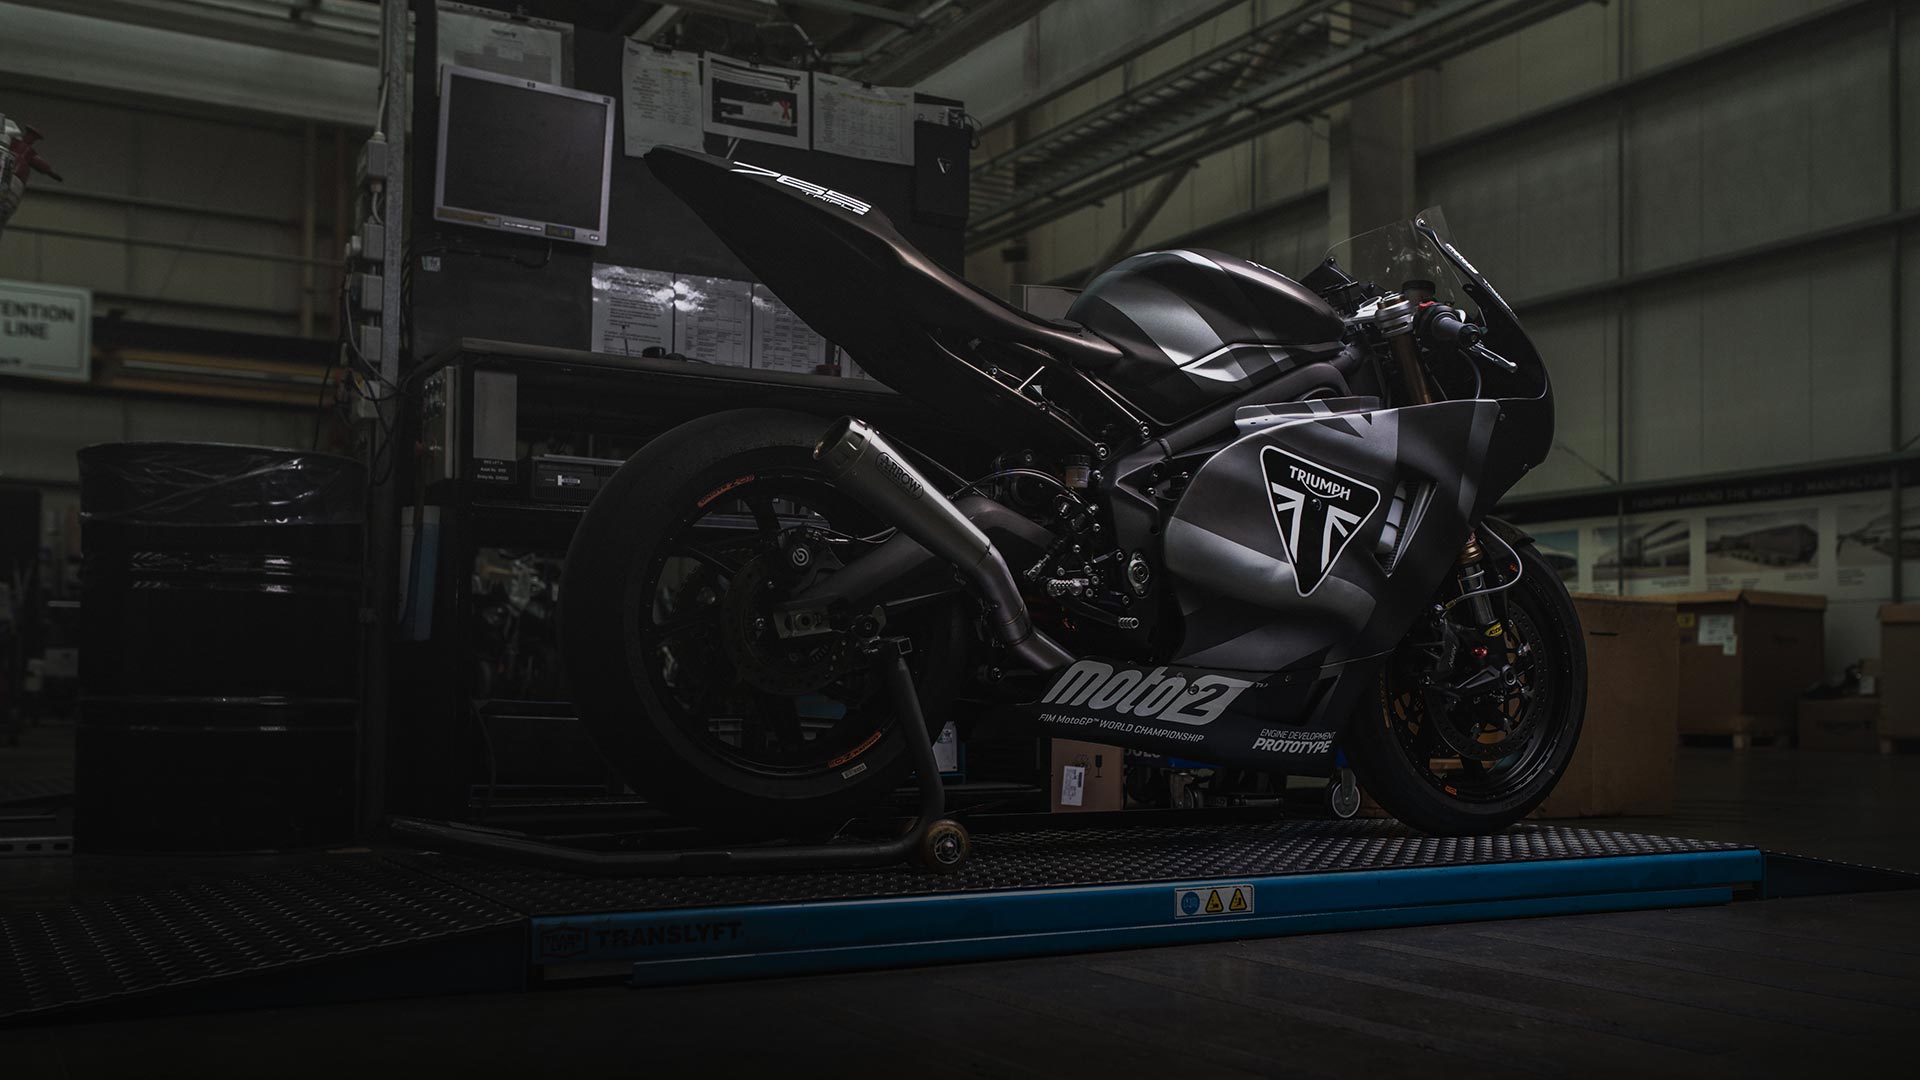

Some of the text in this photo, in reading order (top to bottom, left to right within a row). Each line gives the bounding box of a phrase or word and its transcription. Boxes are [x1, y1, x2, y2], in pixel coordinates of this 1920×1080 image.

[730, 160, 872, 212] 765
[4, 320, 50, 340] LINE
[879, 455, 921, 492] ARROW
[1289, 465, 1351, 501] TRIUMPH
[1038, 713, 1056, 722] FIM
[1099, 719, 1135, 733] WORLD
[1134, 724, 1206, 743] CHAMPIONSHIP
[1260, 728, 1337, 741] ENGINE DEVELOPMENT
[1252, 737, 1333, 754] PROTOTYPE
[596, 921, 743, 948] TRANSLYFT
